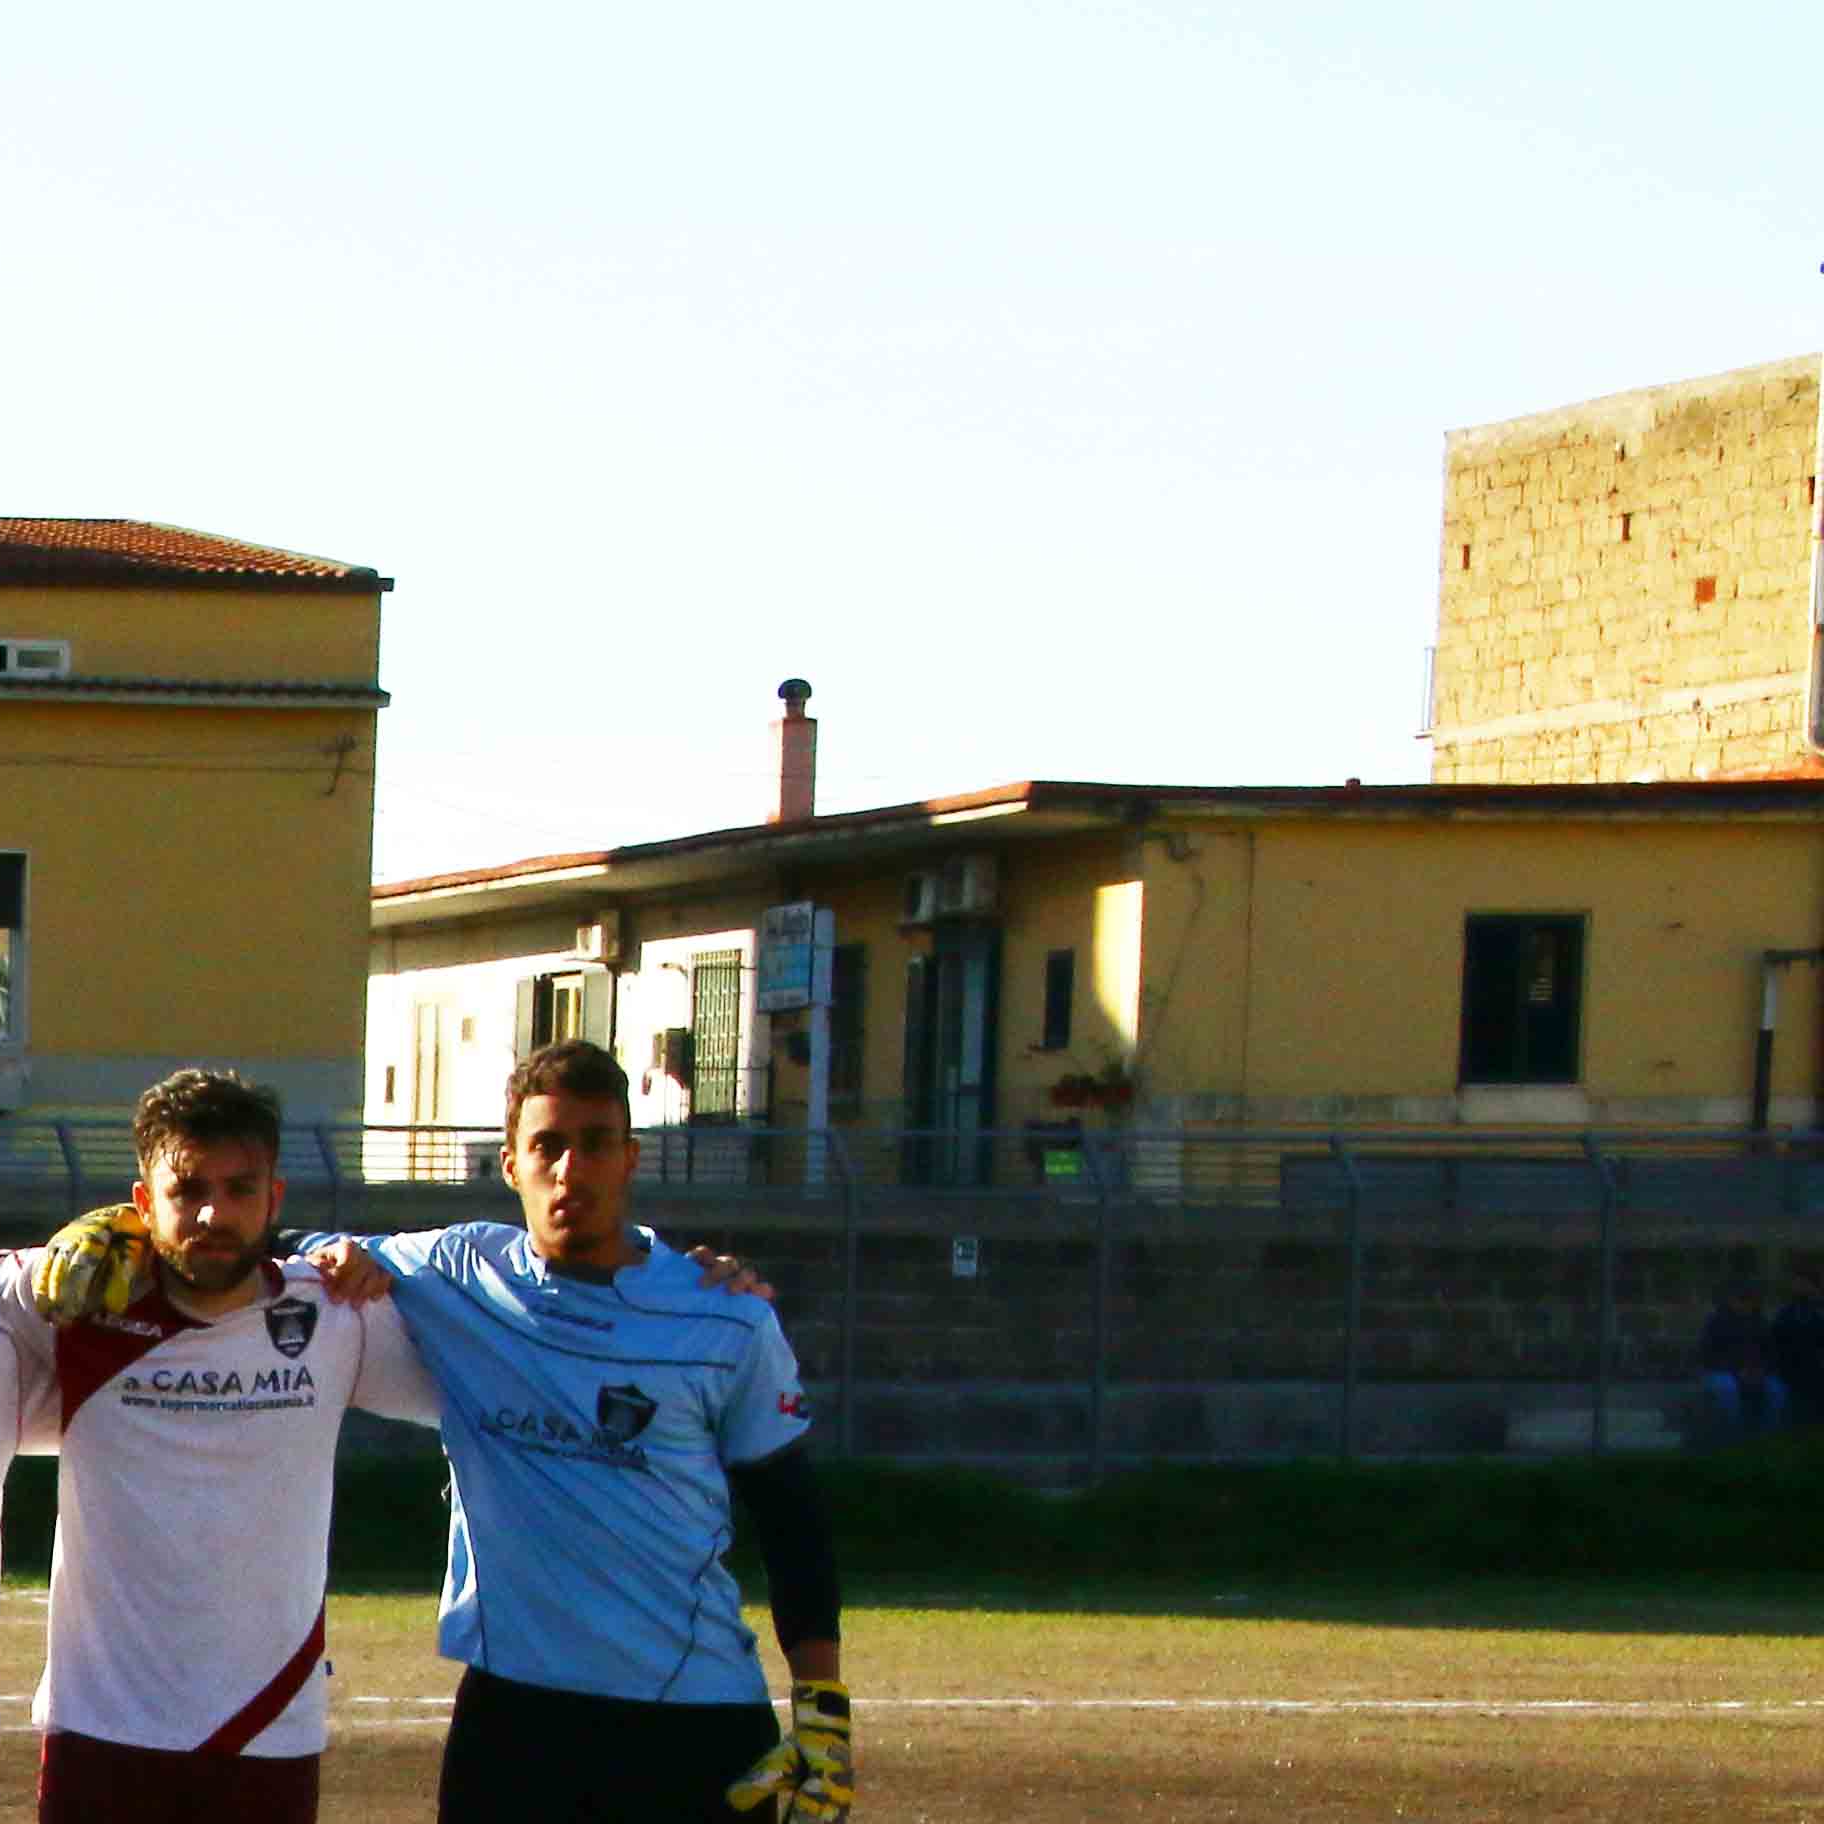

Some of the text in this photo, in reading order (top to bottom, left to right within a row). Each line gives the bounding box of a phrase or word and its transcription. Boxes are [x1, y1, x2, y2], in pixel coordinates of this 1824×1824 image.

[124, 1365, 314, 1395] a CASA MIA
